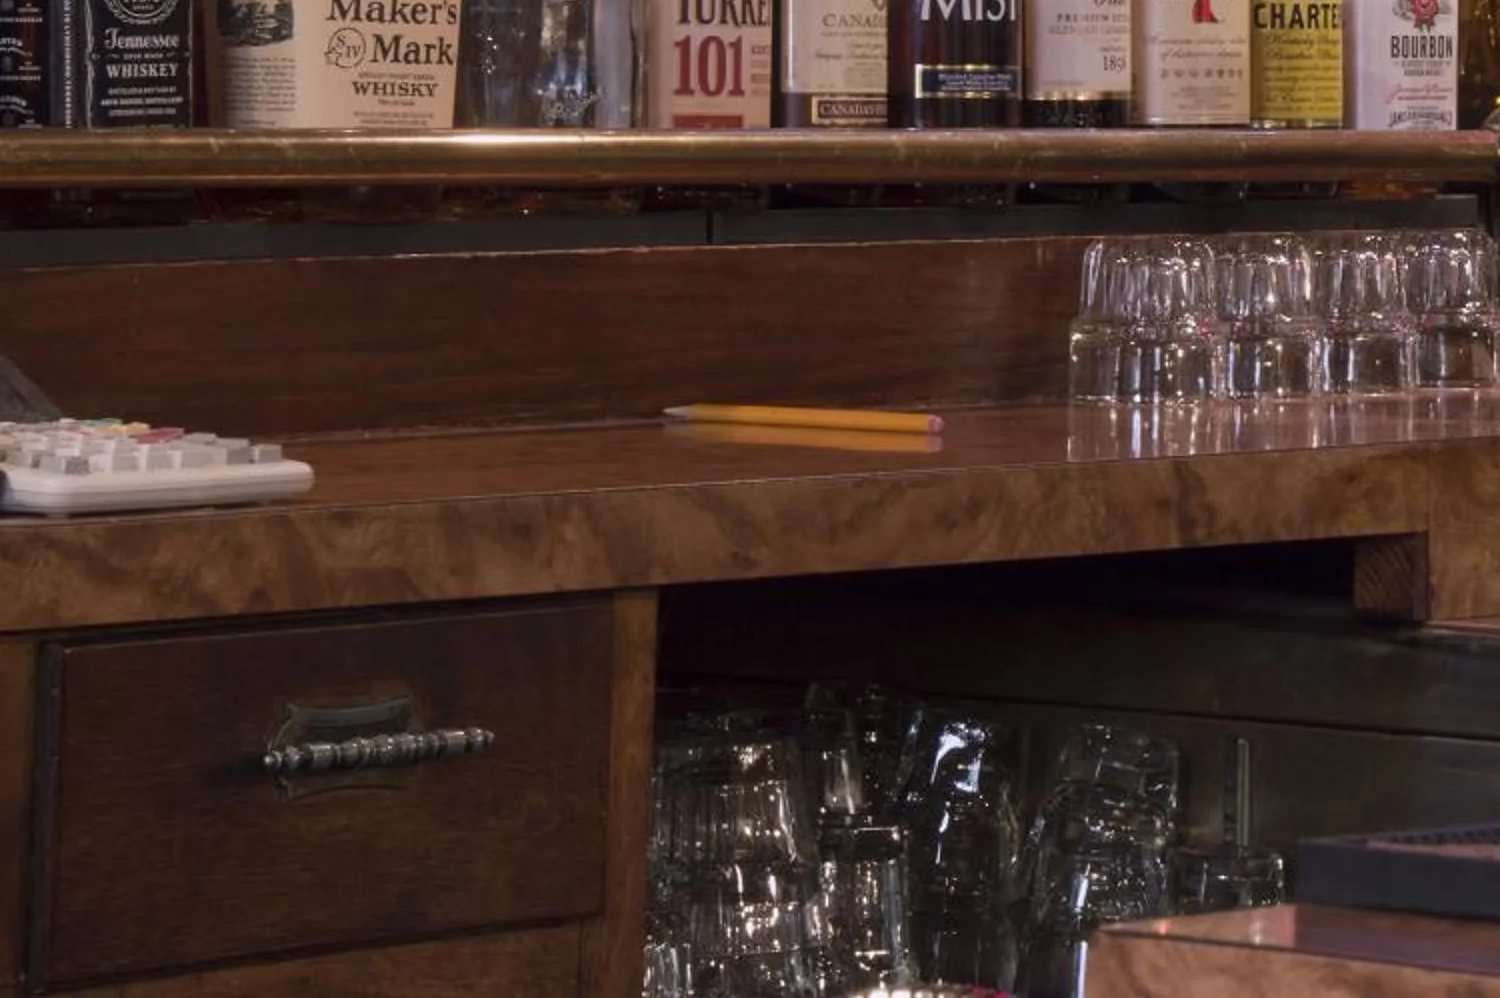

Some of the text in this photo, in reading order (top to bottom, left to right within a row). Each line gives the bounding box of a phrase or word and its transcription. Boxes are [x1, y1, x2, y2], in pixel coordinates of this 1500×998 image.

[1254, 2, 1342, 30] CHARTE
[104, 28, 180, 50] Tennessee
[370, 33, 455, 66] Mark
[1390, 34, 1454, 59] BOURBON
[105, 63, 179, 79] WHISKEY
[673, 34, 746, 98] 101
[351, 80, 439, 98] WHISKY
